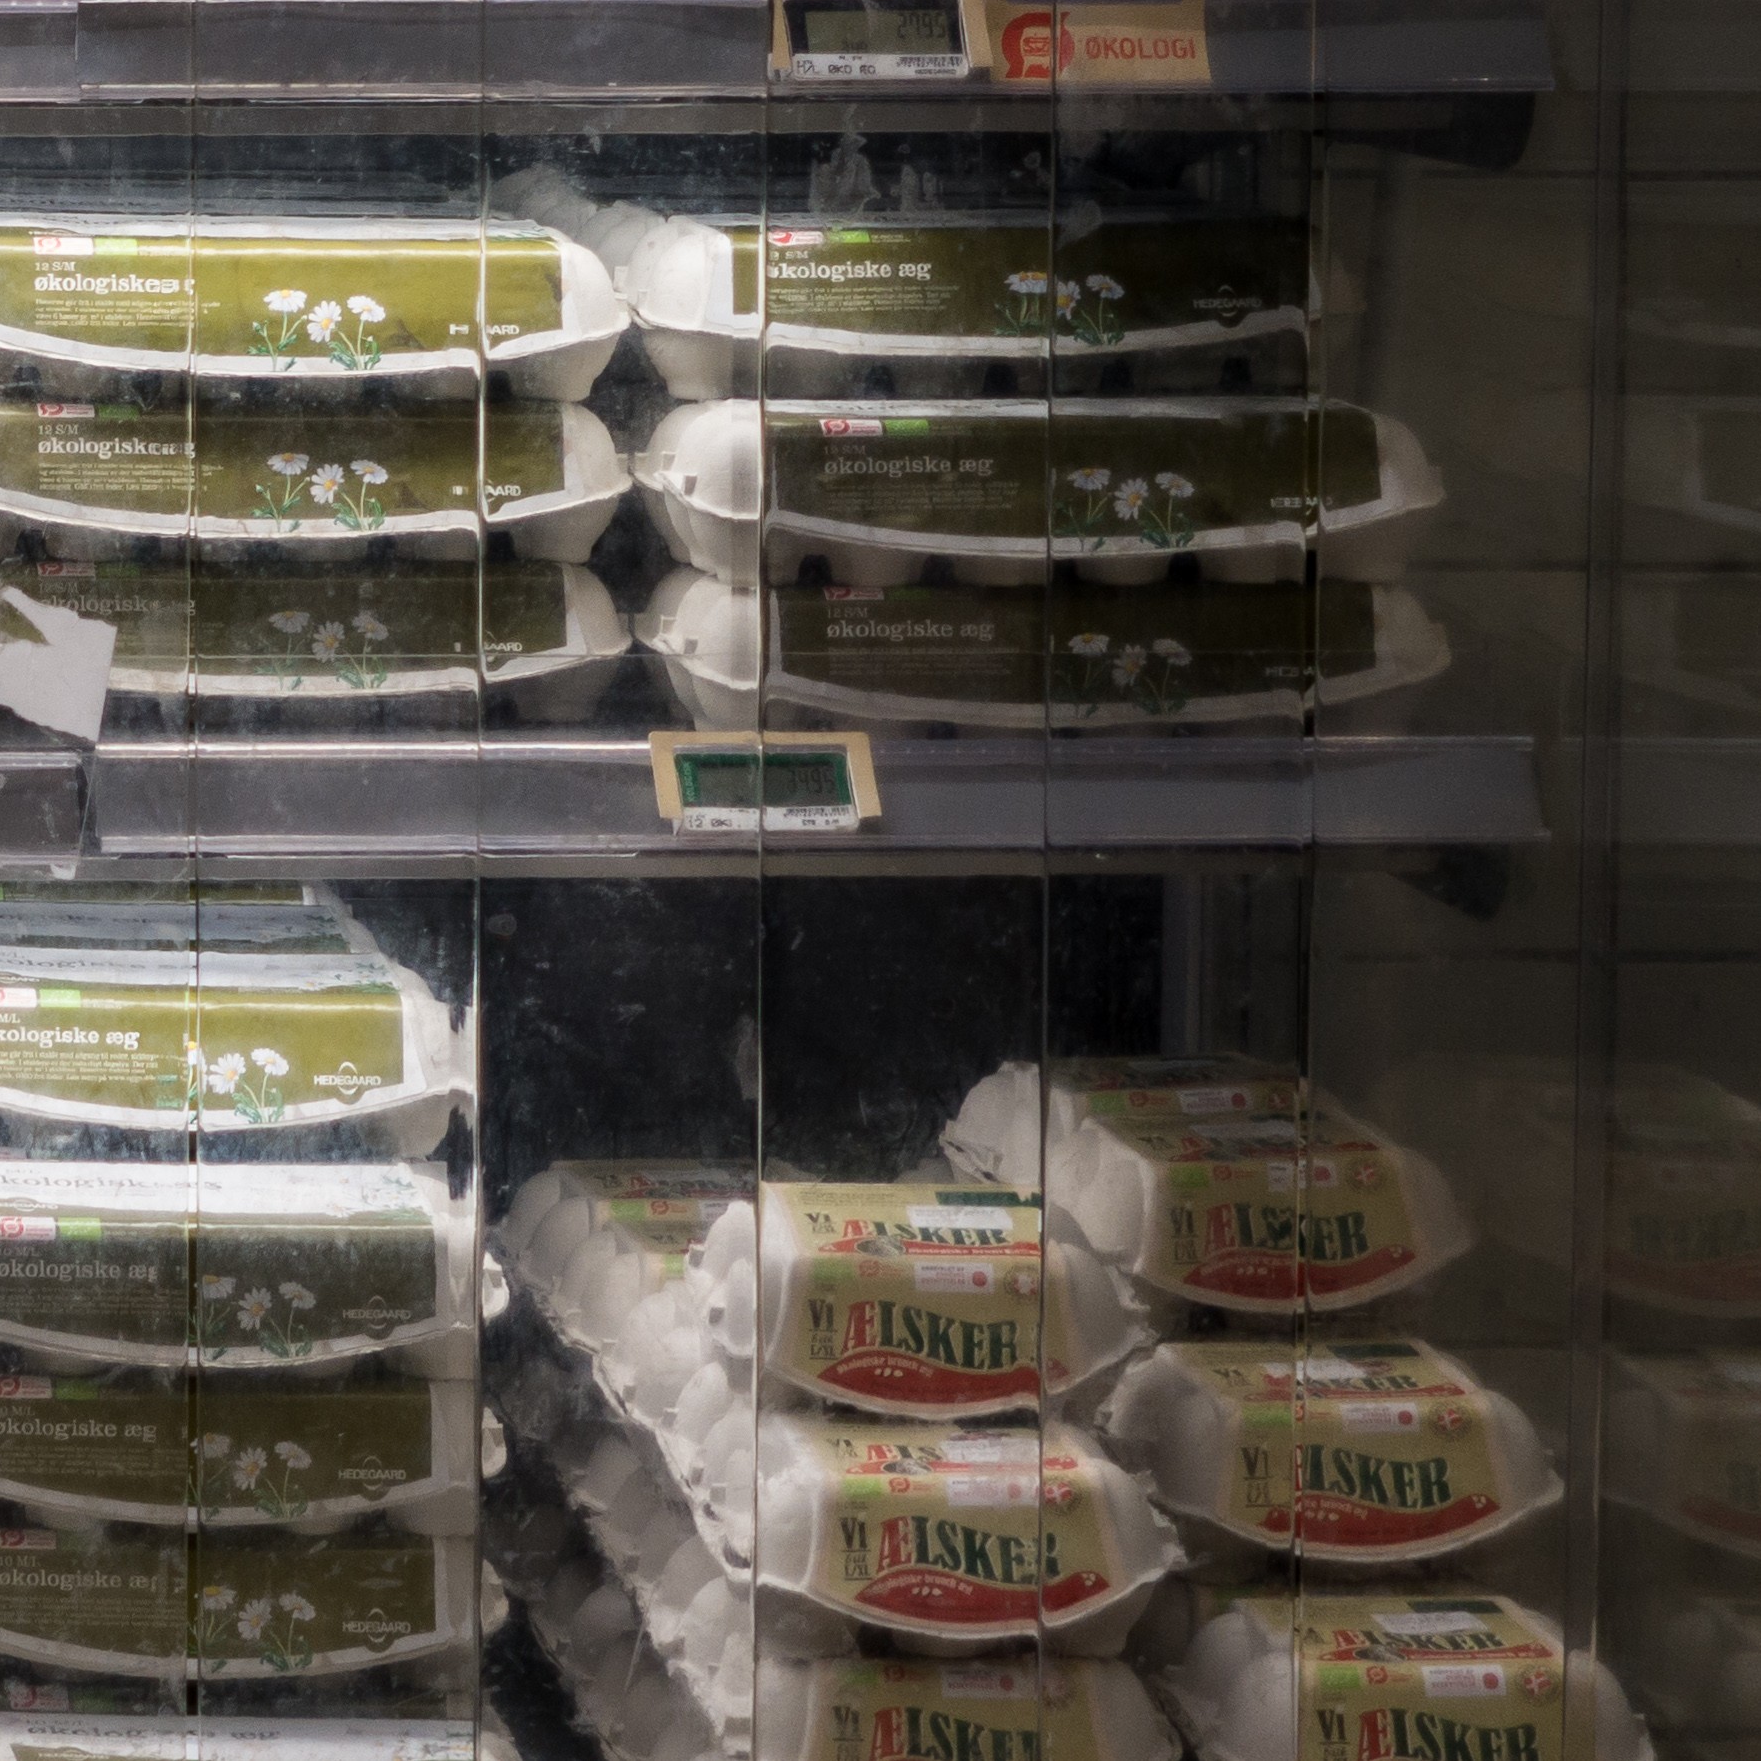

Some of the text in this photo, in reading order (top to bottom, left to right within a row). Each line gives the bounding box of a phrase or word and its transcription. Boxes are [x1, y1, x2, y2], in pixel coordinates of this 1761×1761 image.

[1084, 38, 1196, 61] ØKOLOGI
[35, 261, 76, 272] 12 S/M
[898, 262, 932, 282] æg
[56, 425, 79, 436] S/M
[824, 455, 952, 478] økologiske
[827, 619, 995, 641] økologiske æg
[105, 1031, 140, 1050] æg
[314, 1074, 382, 1086] HEDEGAARD
[808, 1300, 1019, 1369] VI ÆLSKER
[1241, 1443, 1451, 1508] VI LSKER
[840, 1518, 867, 1550] VI
[343, 1621, 412, 1633] HEDEGAARD
